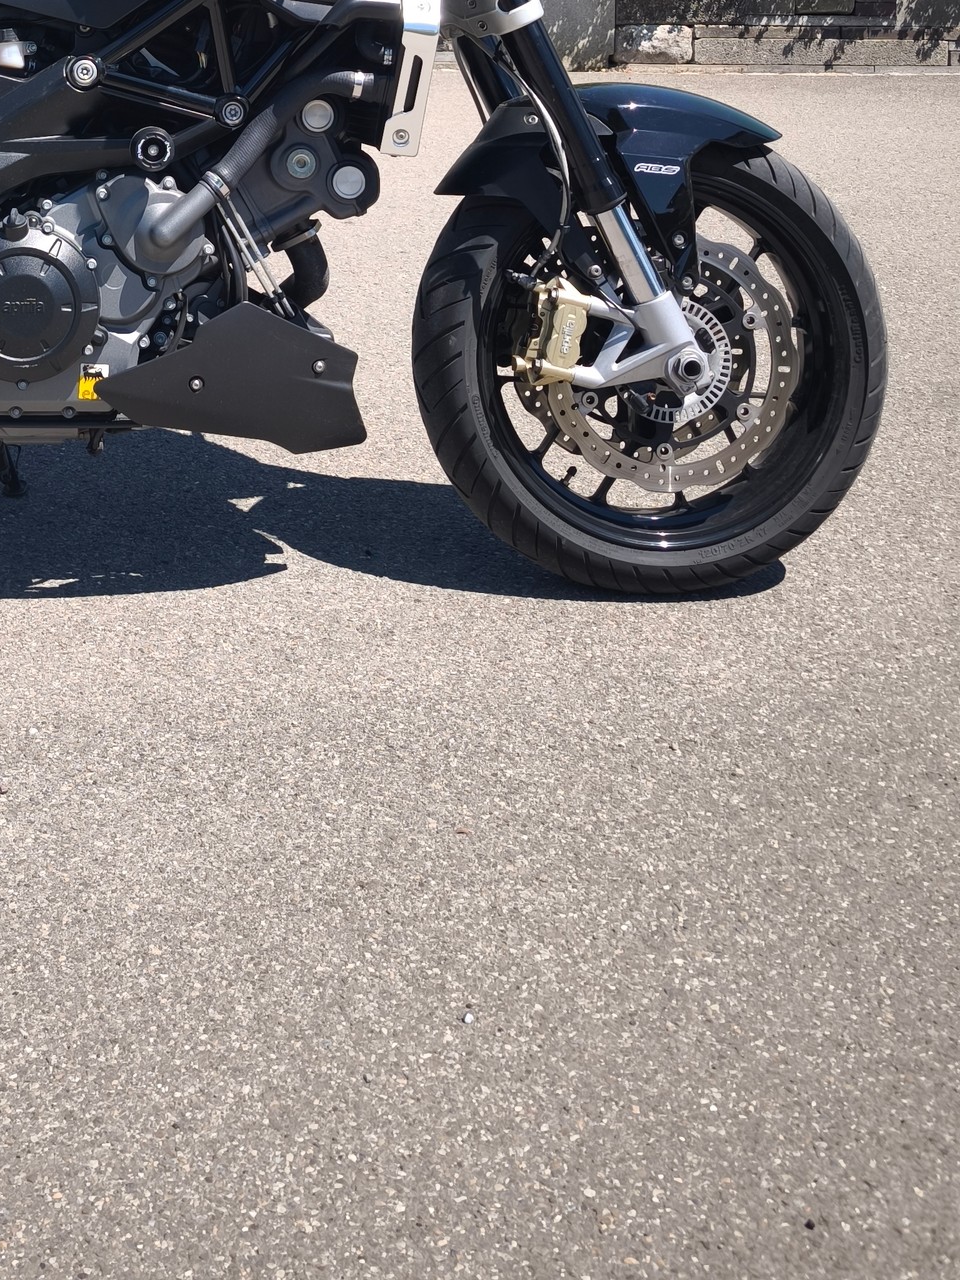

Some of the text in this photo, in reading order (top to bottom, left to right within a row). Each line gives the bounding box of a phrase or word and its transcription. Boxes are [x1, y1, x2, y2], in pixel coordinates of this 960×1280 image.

[634, 162, 681, 175] ABS
[2, 297, 45, 318] aprilia
[560, 319, 576, 355] aprilia
